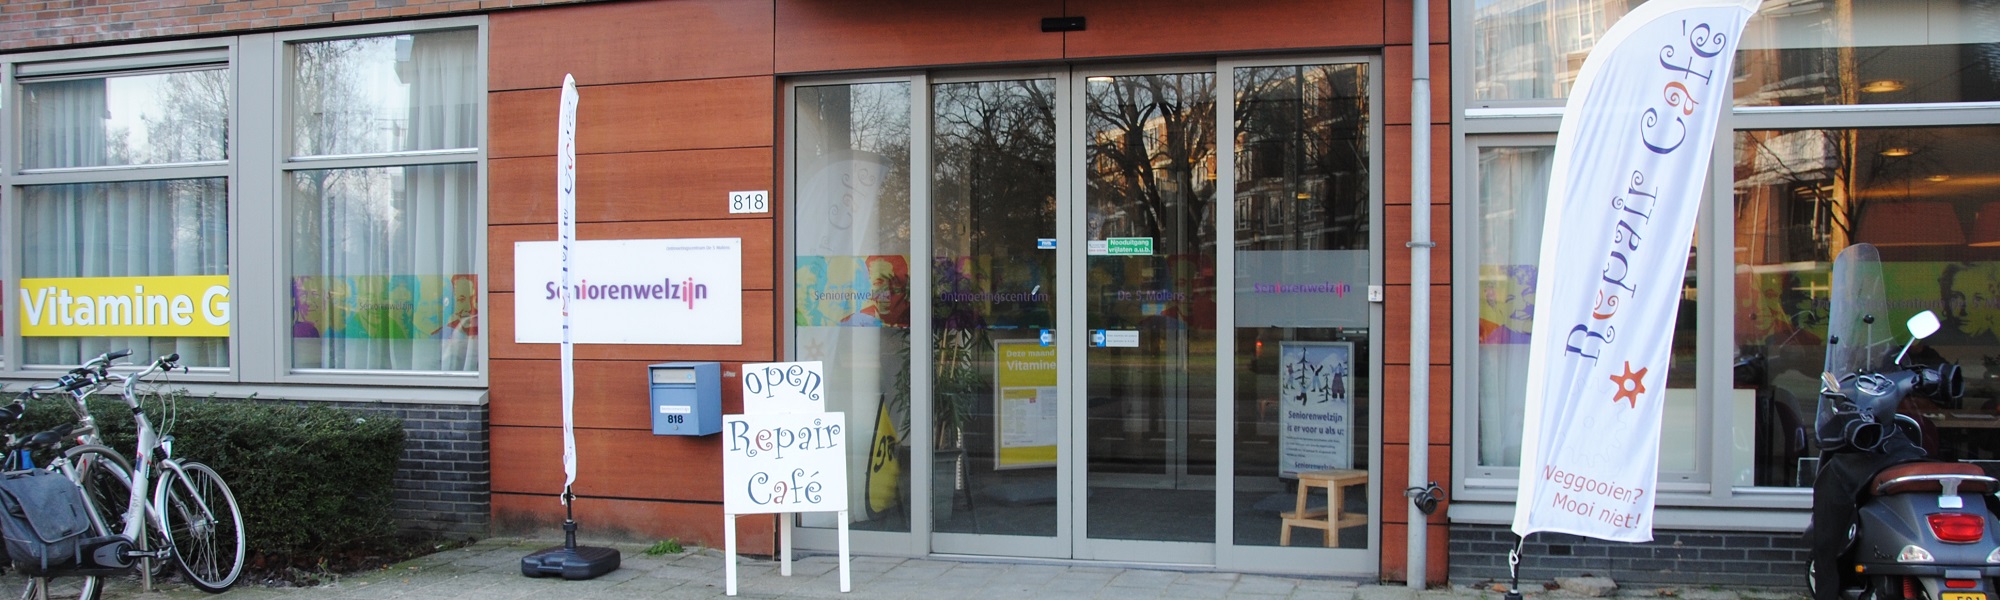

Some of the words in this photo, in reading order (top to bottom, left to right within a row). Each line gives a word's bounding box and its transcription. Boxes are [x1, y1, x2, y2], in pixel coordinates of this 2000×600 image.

[733, 194, 764, 210] 818
[1564, 170, 1658, 367] Repair
[1641, 19, 1727, 155] Café
[1117, 290, 1132, 301] De
[1254, 281, 1351, 299] Seniorenwelzijn
[21, 285, 194, 326] Vitamine
[201, 285, 229, 326] G
[1028, 349, 1055, 357] maand
[1006, 360, 1057, 371] Vitamine
[745, 365, 822, 401] open
[667, 414, 684, 424] 818
[1288, 410, 1343, 423] Seniorenwelzijn
[728, 418, 841, 459] Repair
[747, 468, 822, 505] Café
[1552, 492, 1596, 517] Mooi
[1598, 508, 1642, 529] niet!
